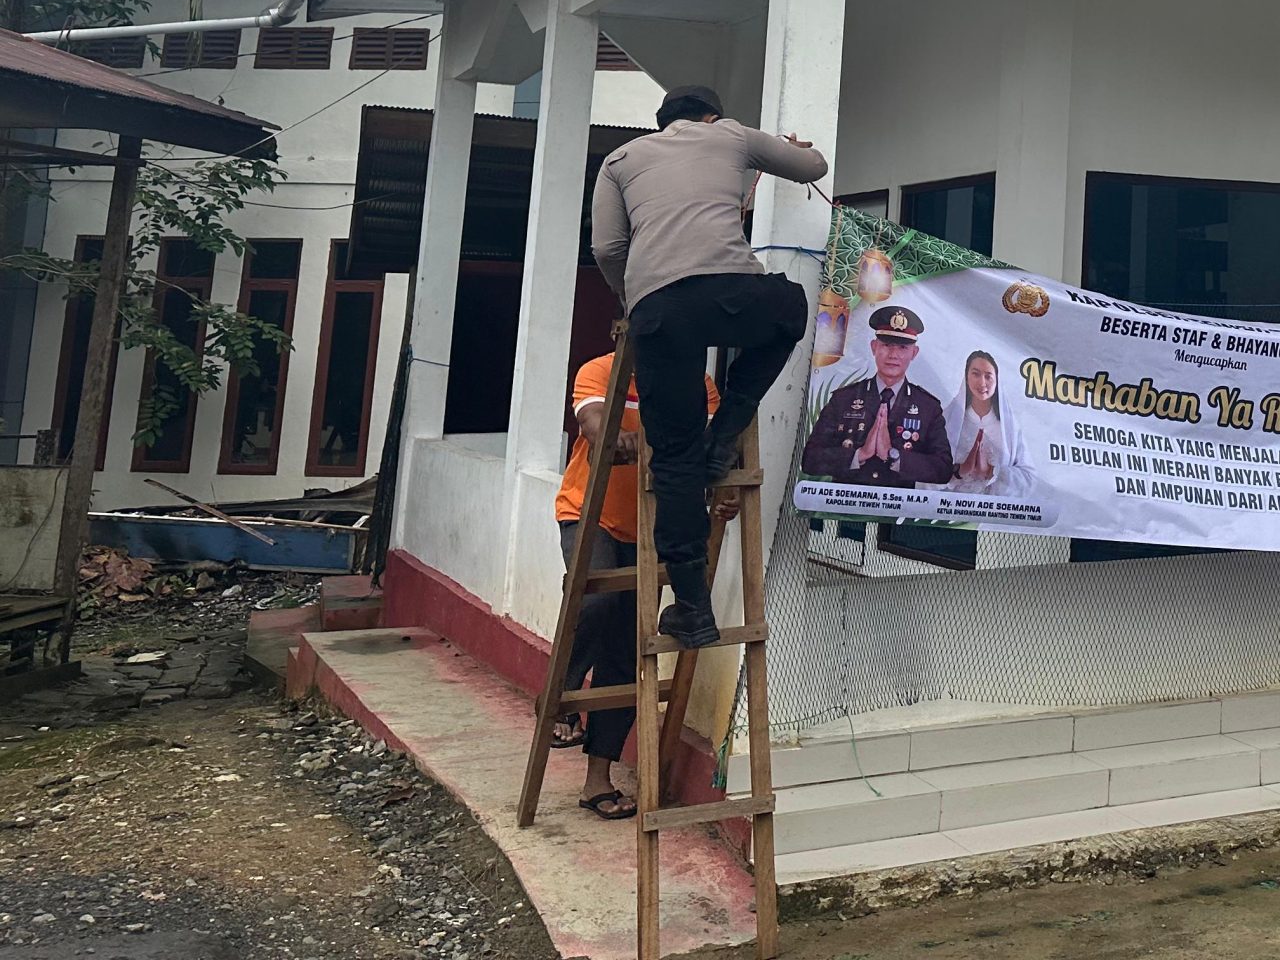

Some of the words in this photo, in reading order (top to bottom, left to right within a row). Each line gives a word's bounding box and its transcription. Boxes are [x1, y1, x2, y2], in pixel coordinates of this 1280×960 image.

[1100, 316, 1167, 342] BESERTA
[1171, 326, 1208, 347] STAF
[1211, 333, 1222, 350] &
[1174, 348, 1248, 372] Mengucapkan
[1020, 358, 1201, 423] Marhaban
[1208, 385, 1254, 430] Ya
[1074, 422, 1137, 448] SEMOGA
[1141, 433, 1174, 453] KITA
[1176, 438, 1215, 459] YANG
[1050, 443, 1066, 462] DI
[1072, 446, 1122, 470] BULAN
[1127, 454, 1148, 473] INI
[1152, 458, 1211, 481] MERAIH
[1214, 467, 1273, 488] BANYAK
[801, 486, 816, 495] IPTU
[818, 488, 834, 496] ADE
[836, 489, 880, 501] SOEMARNA,
[907, 495, 930, 504] M.A.P.
[826, 498, 857, 507] KAPOLSEK
[859, 500, 880, 509] TEWEH
[940, 499, 952, 508] Ny.
[955, 500, 976, 508] NOVI
[977, 501, 994, 510] ADE
[996, 502, 1041, 514] SOEMARNA
[1115, 476, 1147, 497] DAN
[1151, 481, 1224, 506] AMPUNAN
[1228, 491, 1263, 511] DARI
